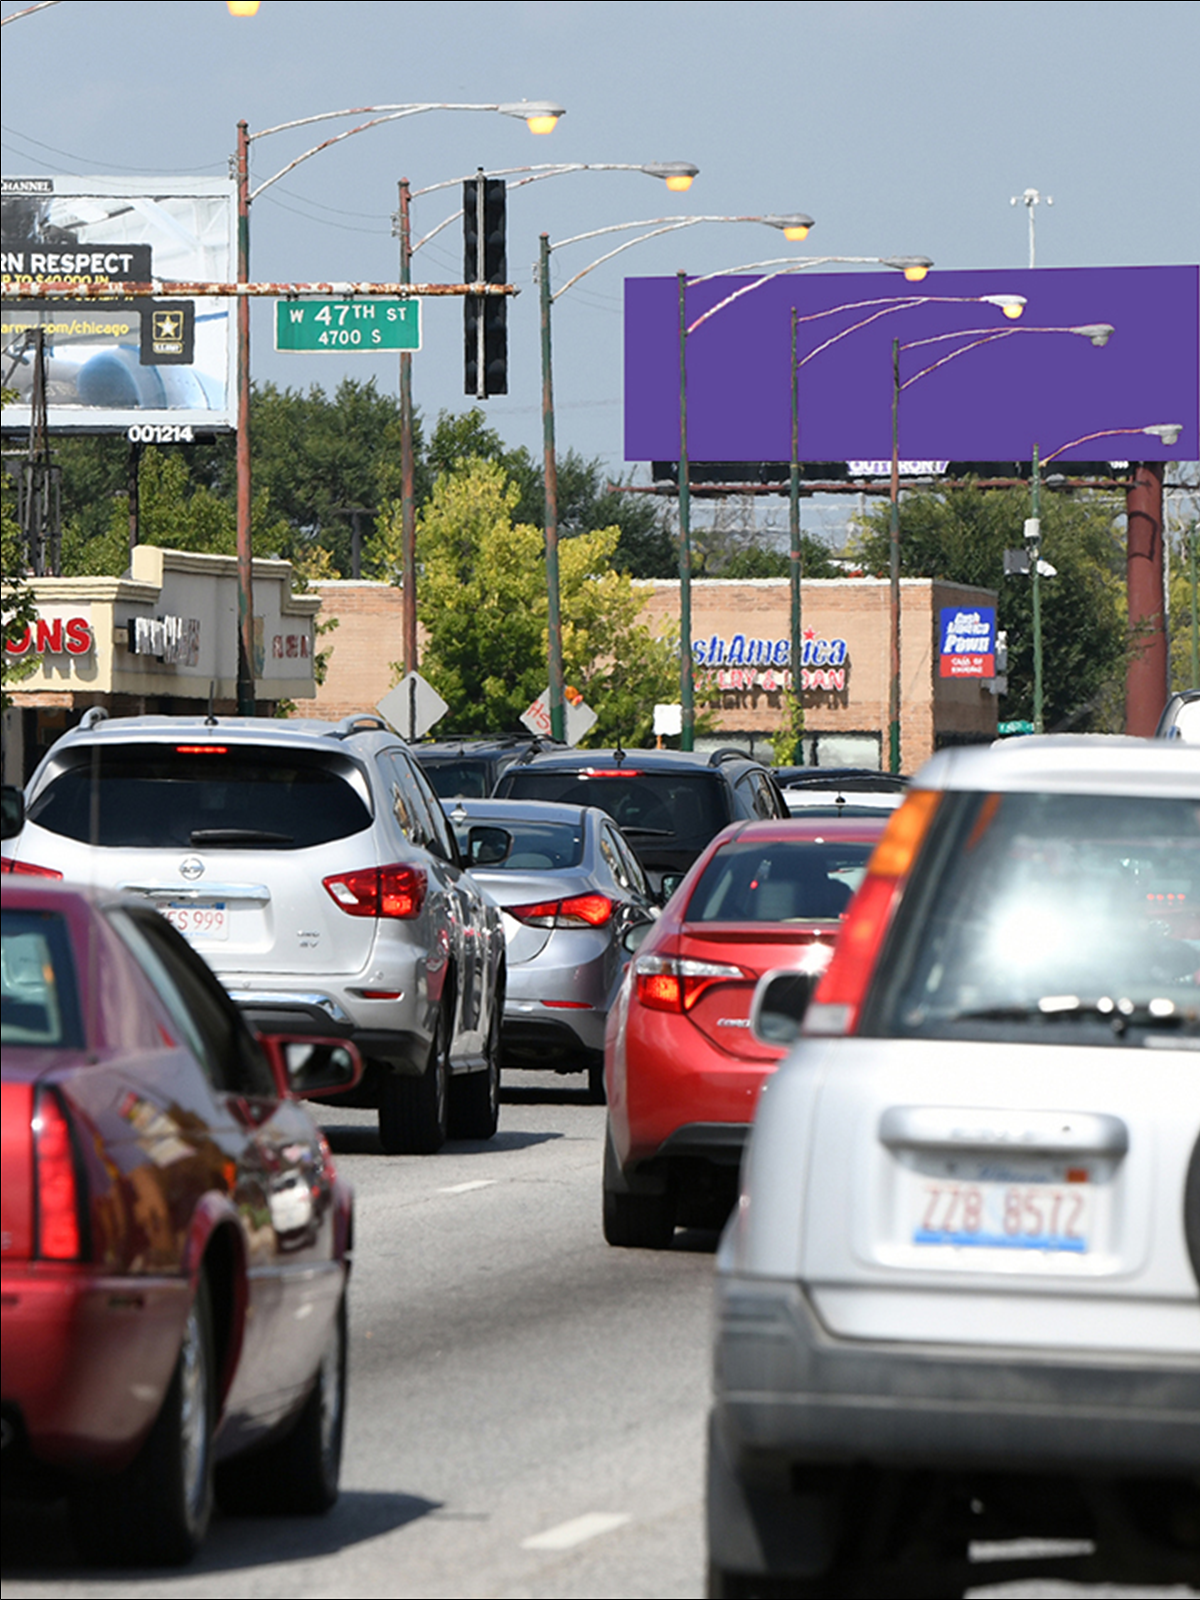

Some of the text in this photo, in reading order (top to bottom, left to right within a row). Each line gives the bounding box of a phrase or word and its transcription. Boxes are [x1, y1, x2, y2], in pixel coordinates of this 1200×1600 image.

[31, 252, 133, 273] RESPECT
[289, 305, 407, 326] W 47TH ST
[1, 319, 129, 337] armcom/chicago
[318, 328, 381, 345] 4700 S
[128, 425, 194, 442] 001214
[846, 460, 949, 475] OUTRONT
[1003, 1187, 1084, 1239] 8572
